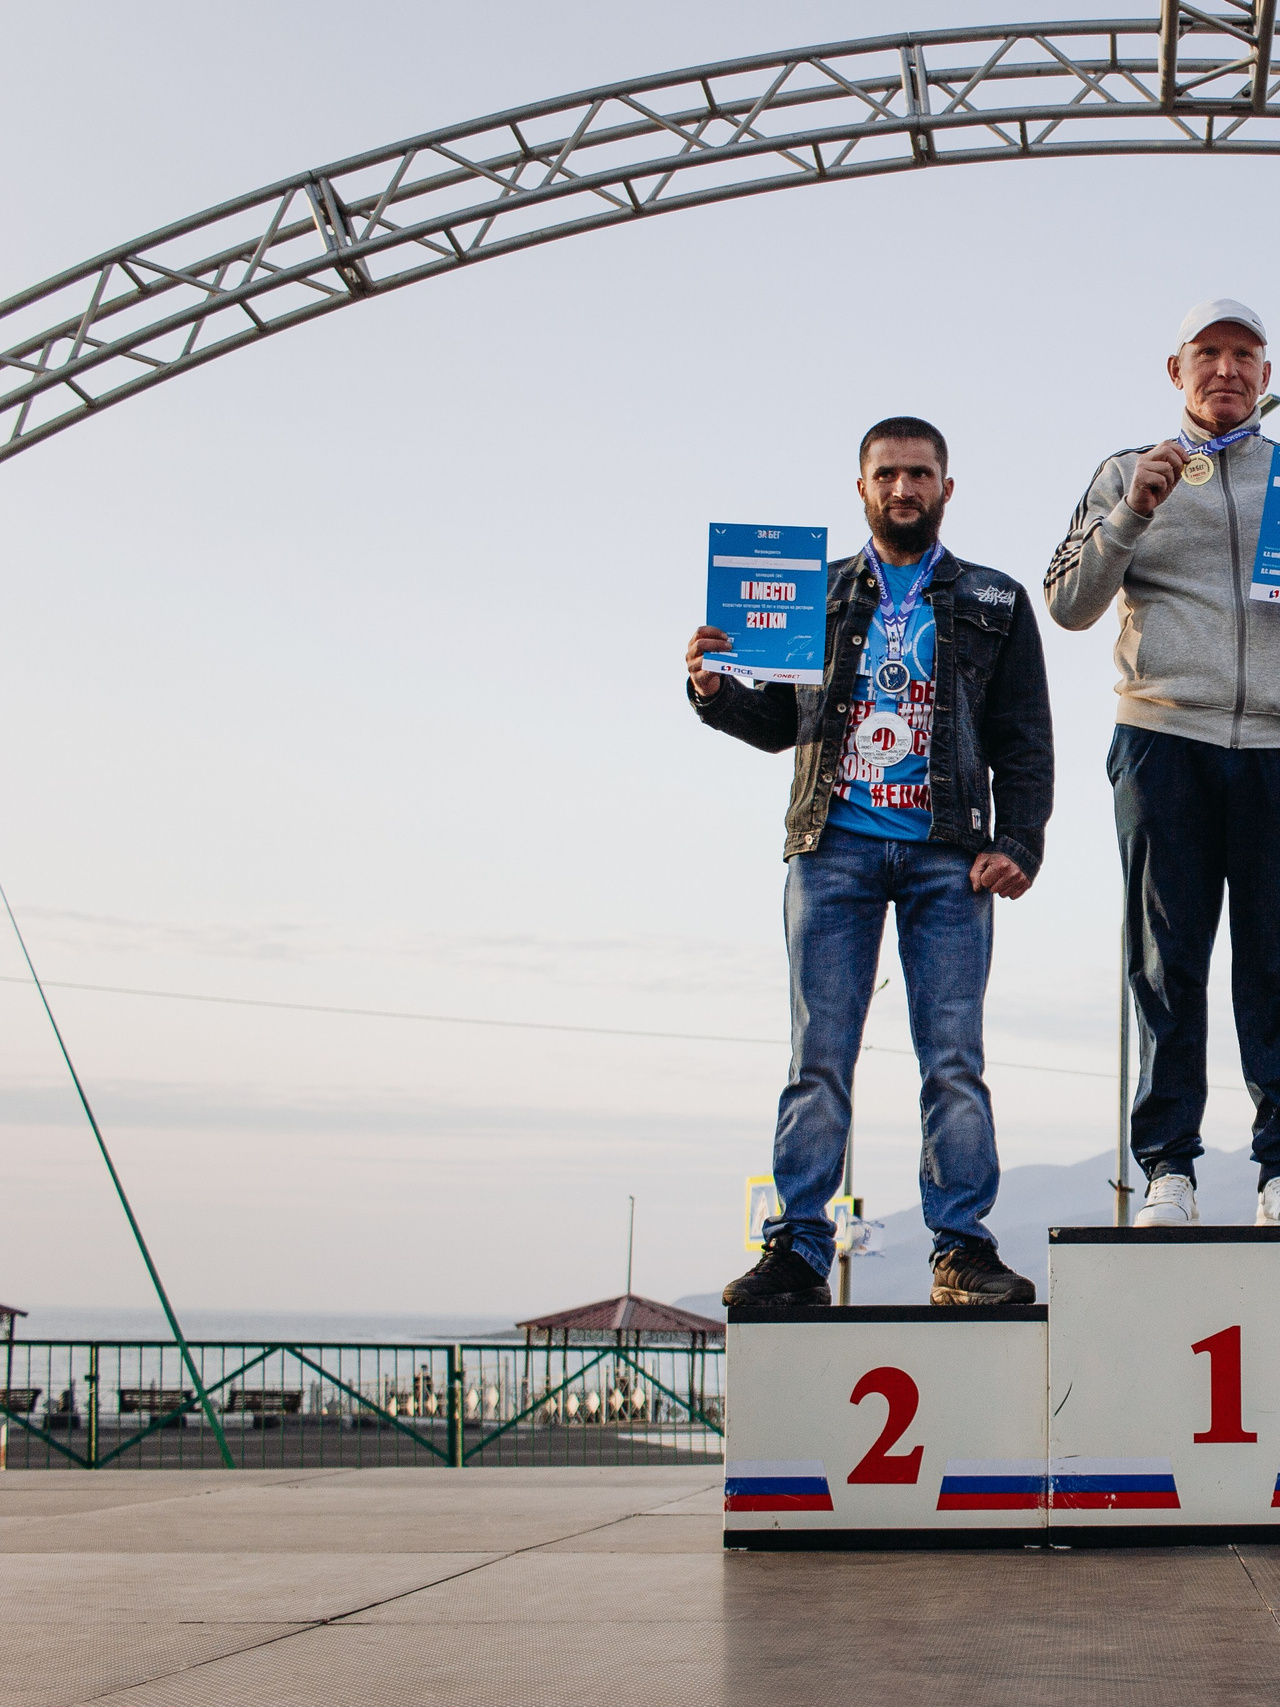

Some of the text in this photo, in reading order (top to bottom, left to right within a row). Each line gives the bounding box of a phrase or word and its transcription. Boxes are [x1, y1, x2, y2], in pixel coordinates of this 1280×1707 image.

[751, 582, 797, 602] МЕСТО
[746, 611, 788, 630] 21,1 КМ
[733, 667, 754, 676] ПСБ
[772, 672, 801, 680] FONBET
[1190, 1325, 1258, 1443] 1
[847, 1366, 925, 1484] 2
